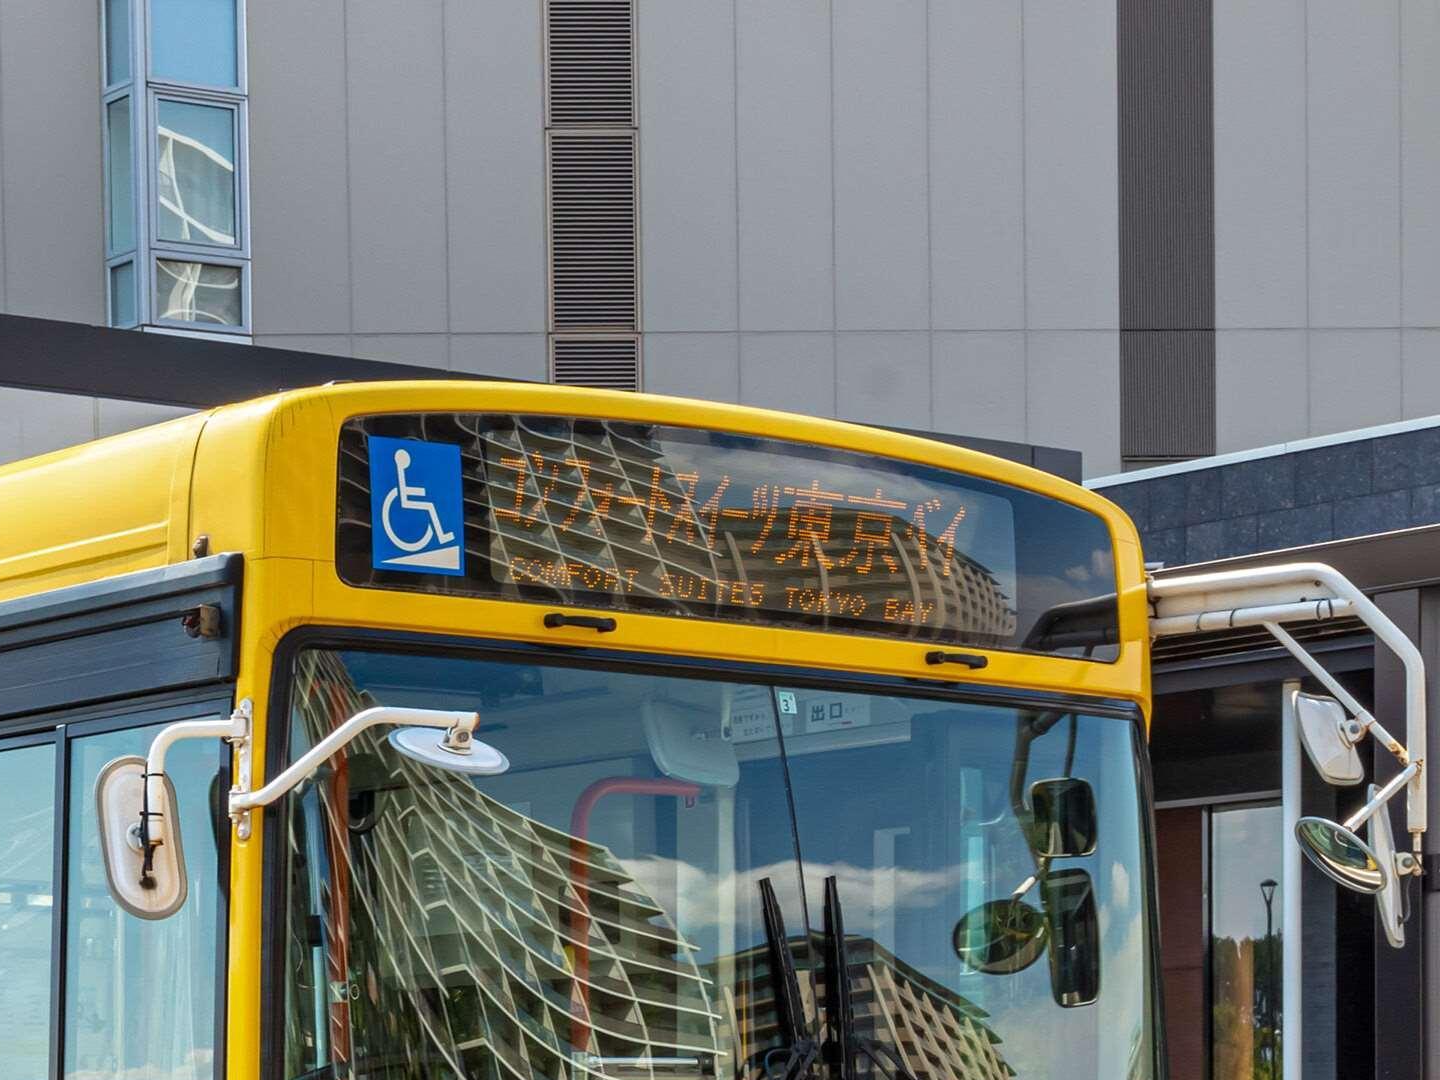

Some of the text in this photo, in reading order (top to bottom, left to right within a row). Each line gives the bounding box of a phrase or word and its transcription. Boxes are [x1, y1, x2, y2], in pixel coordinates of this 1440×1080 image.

[510, 556, 936, 624] COMFORT SUITES TOKYO BAY
[810, 702, 843, 722] 出口
